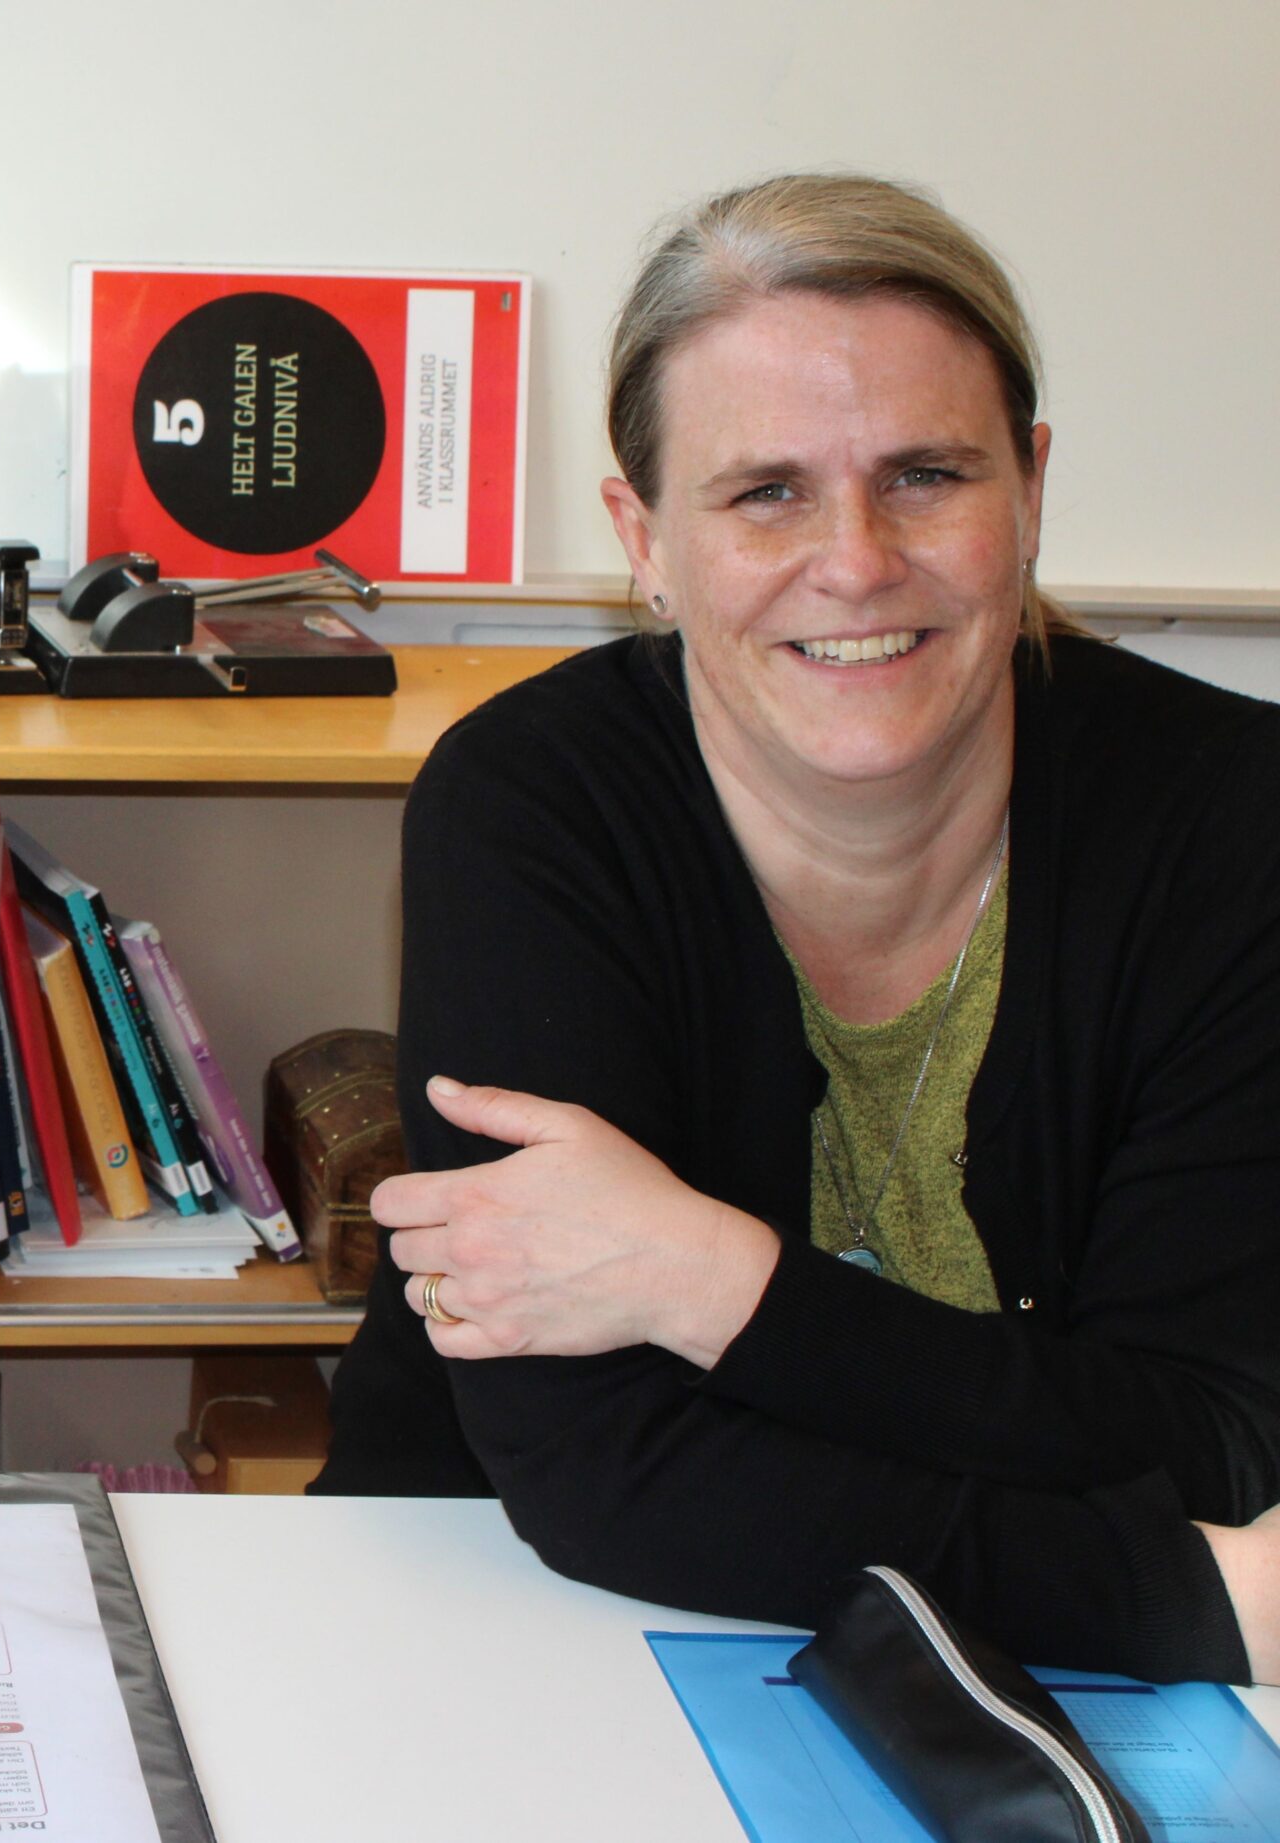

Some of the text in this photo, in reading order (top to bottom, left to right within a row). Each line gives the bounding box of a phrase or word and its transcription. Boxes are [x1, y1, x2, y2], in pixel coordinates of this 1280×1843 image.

[153, 399, 205, 446] 5
[232, 344, 257, 496] HELT GALEN
[270, 352, 299, 488] LJUDNIVÅ
[415, 354, 436, 508] ANVÄNDS ALDRIG
[439, 360, 458, 493] KLASSRUMMET
[8, 1821, 46, 1830] Det
